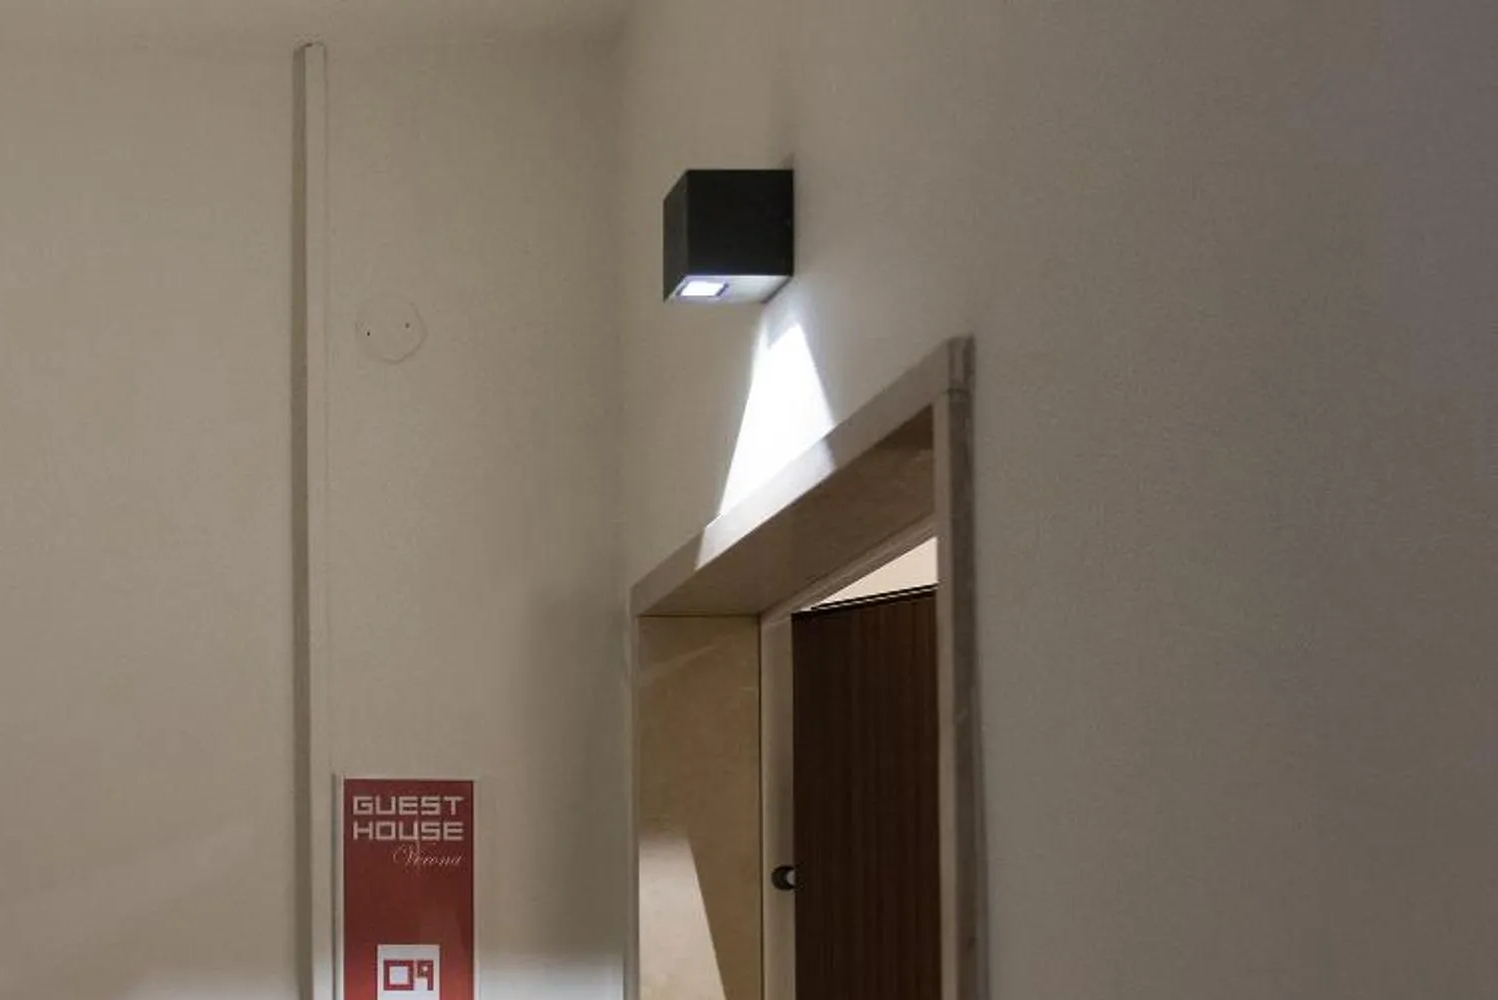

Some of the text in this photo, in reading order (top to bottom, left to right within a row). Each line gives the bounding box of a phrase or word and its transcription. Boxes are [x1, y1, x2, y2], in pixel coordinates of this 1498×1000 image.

[352, 795, 465, 816] GUEST
[352, 821, 464, 841] HOUSE
[383, 960, 434, 991] 09
